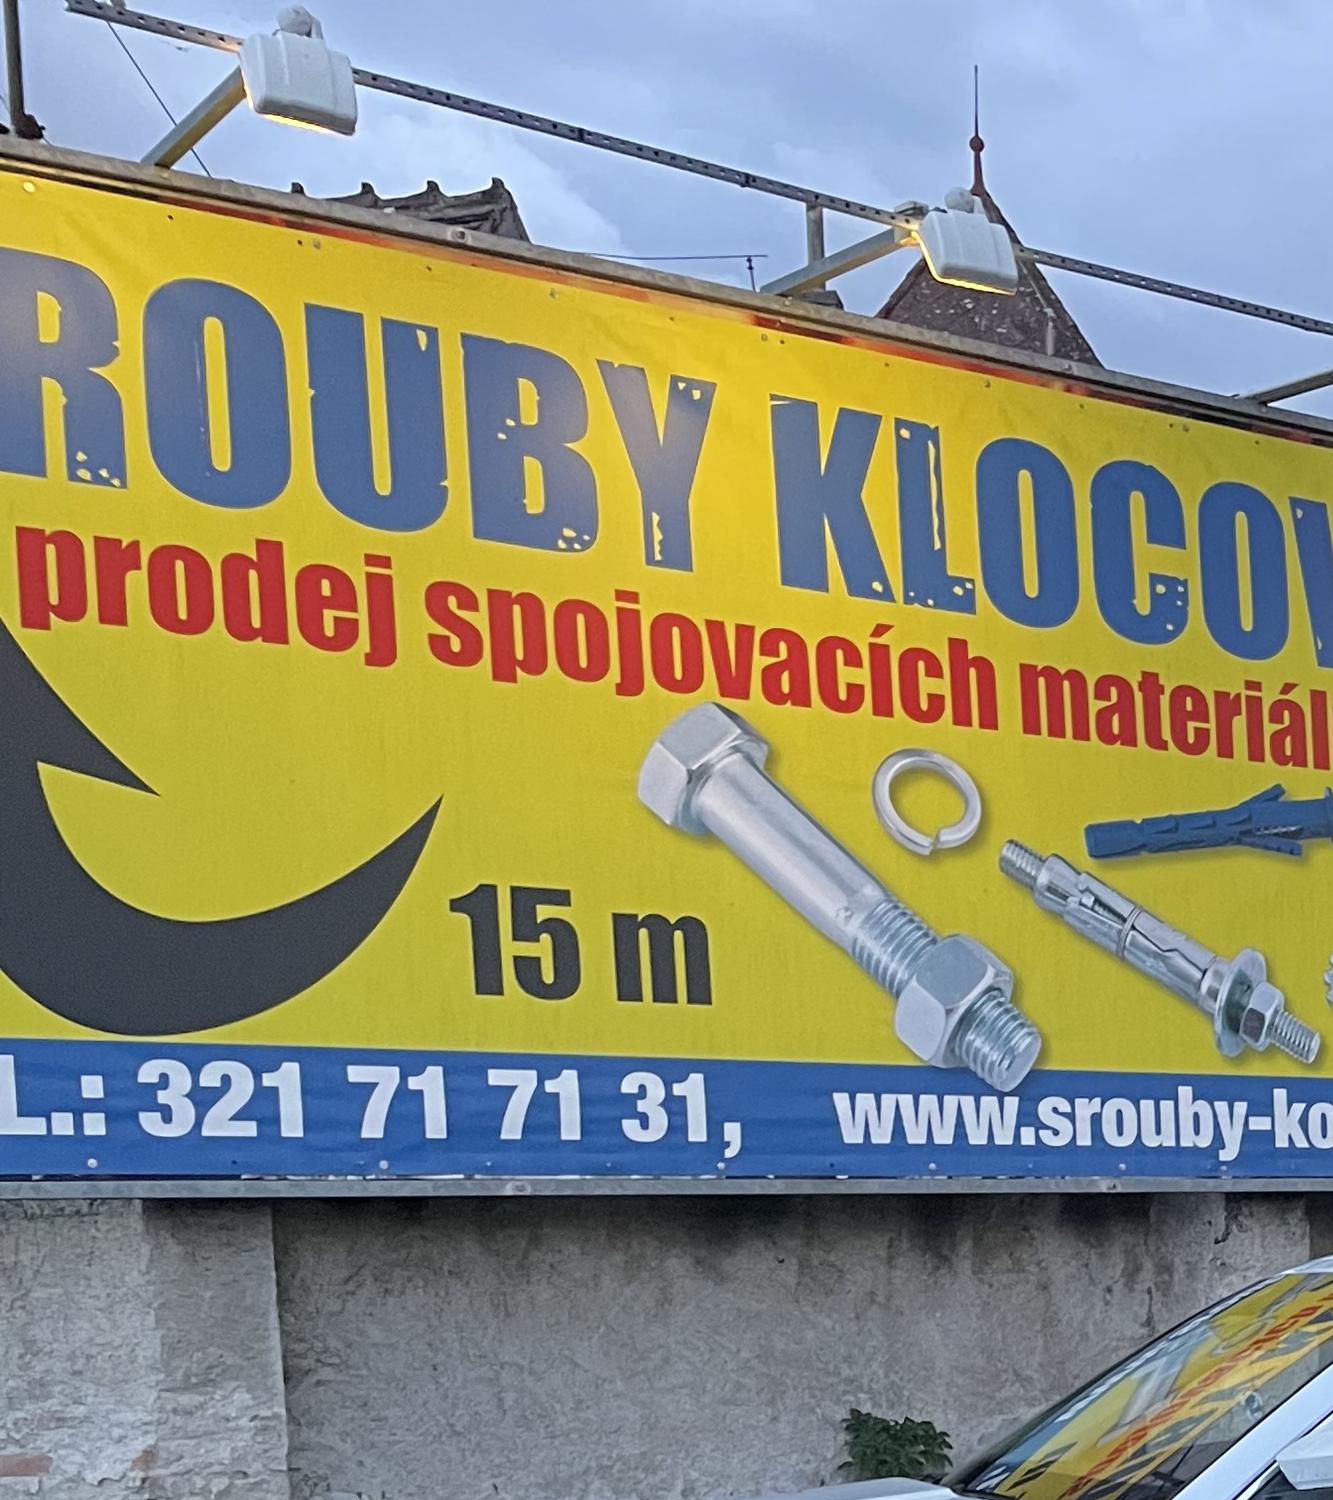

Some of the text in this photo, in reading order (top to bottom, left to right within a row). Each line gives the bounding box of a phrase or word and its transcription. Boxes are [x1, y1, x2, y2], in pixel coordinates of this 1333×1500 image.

[0, 246, 717, 572] ROUBY
[15, 526, 398, 667] prodej
[424, 580, 999, 731] spojovacích
[449, 883, 713, 1006] 15 m
[136, 1058, 304, 1139] 321
[347, 1065, 449, 1140] 71
[487, 1068, 582, 1141] 71
[620, 1072, 743, 1159] 31,
